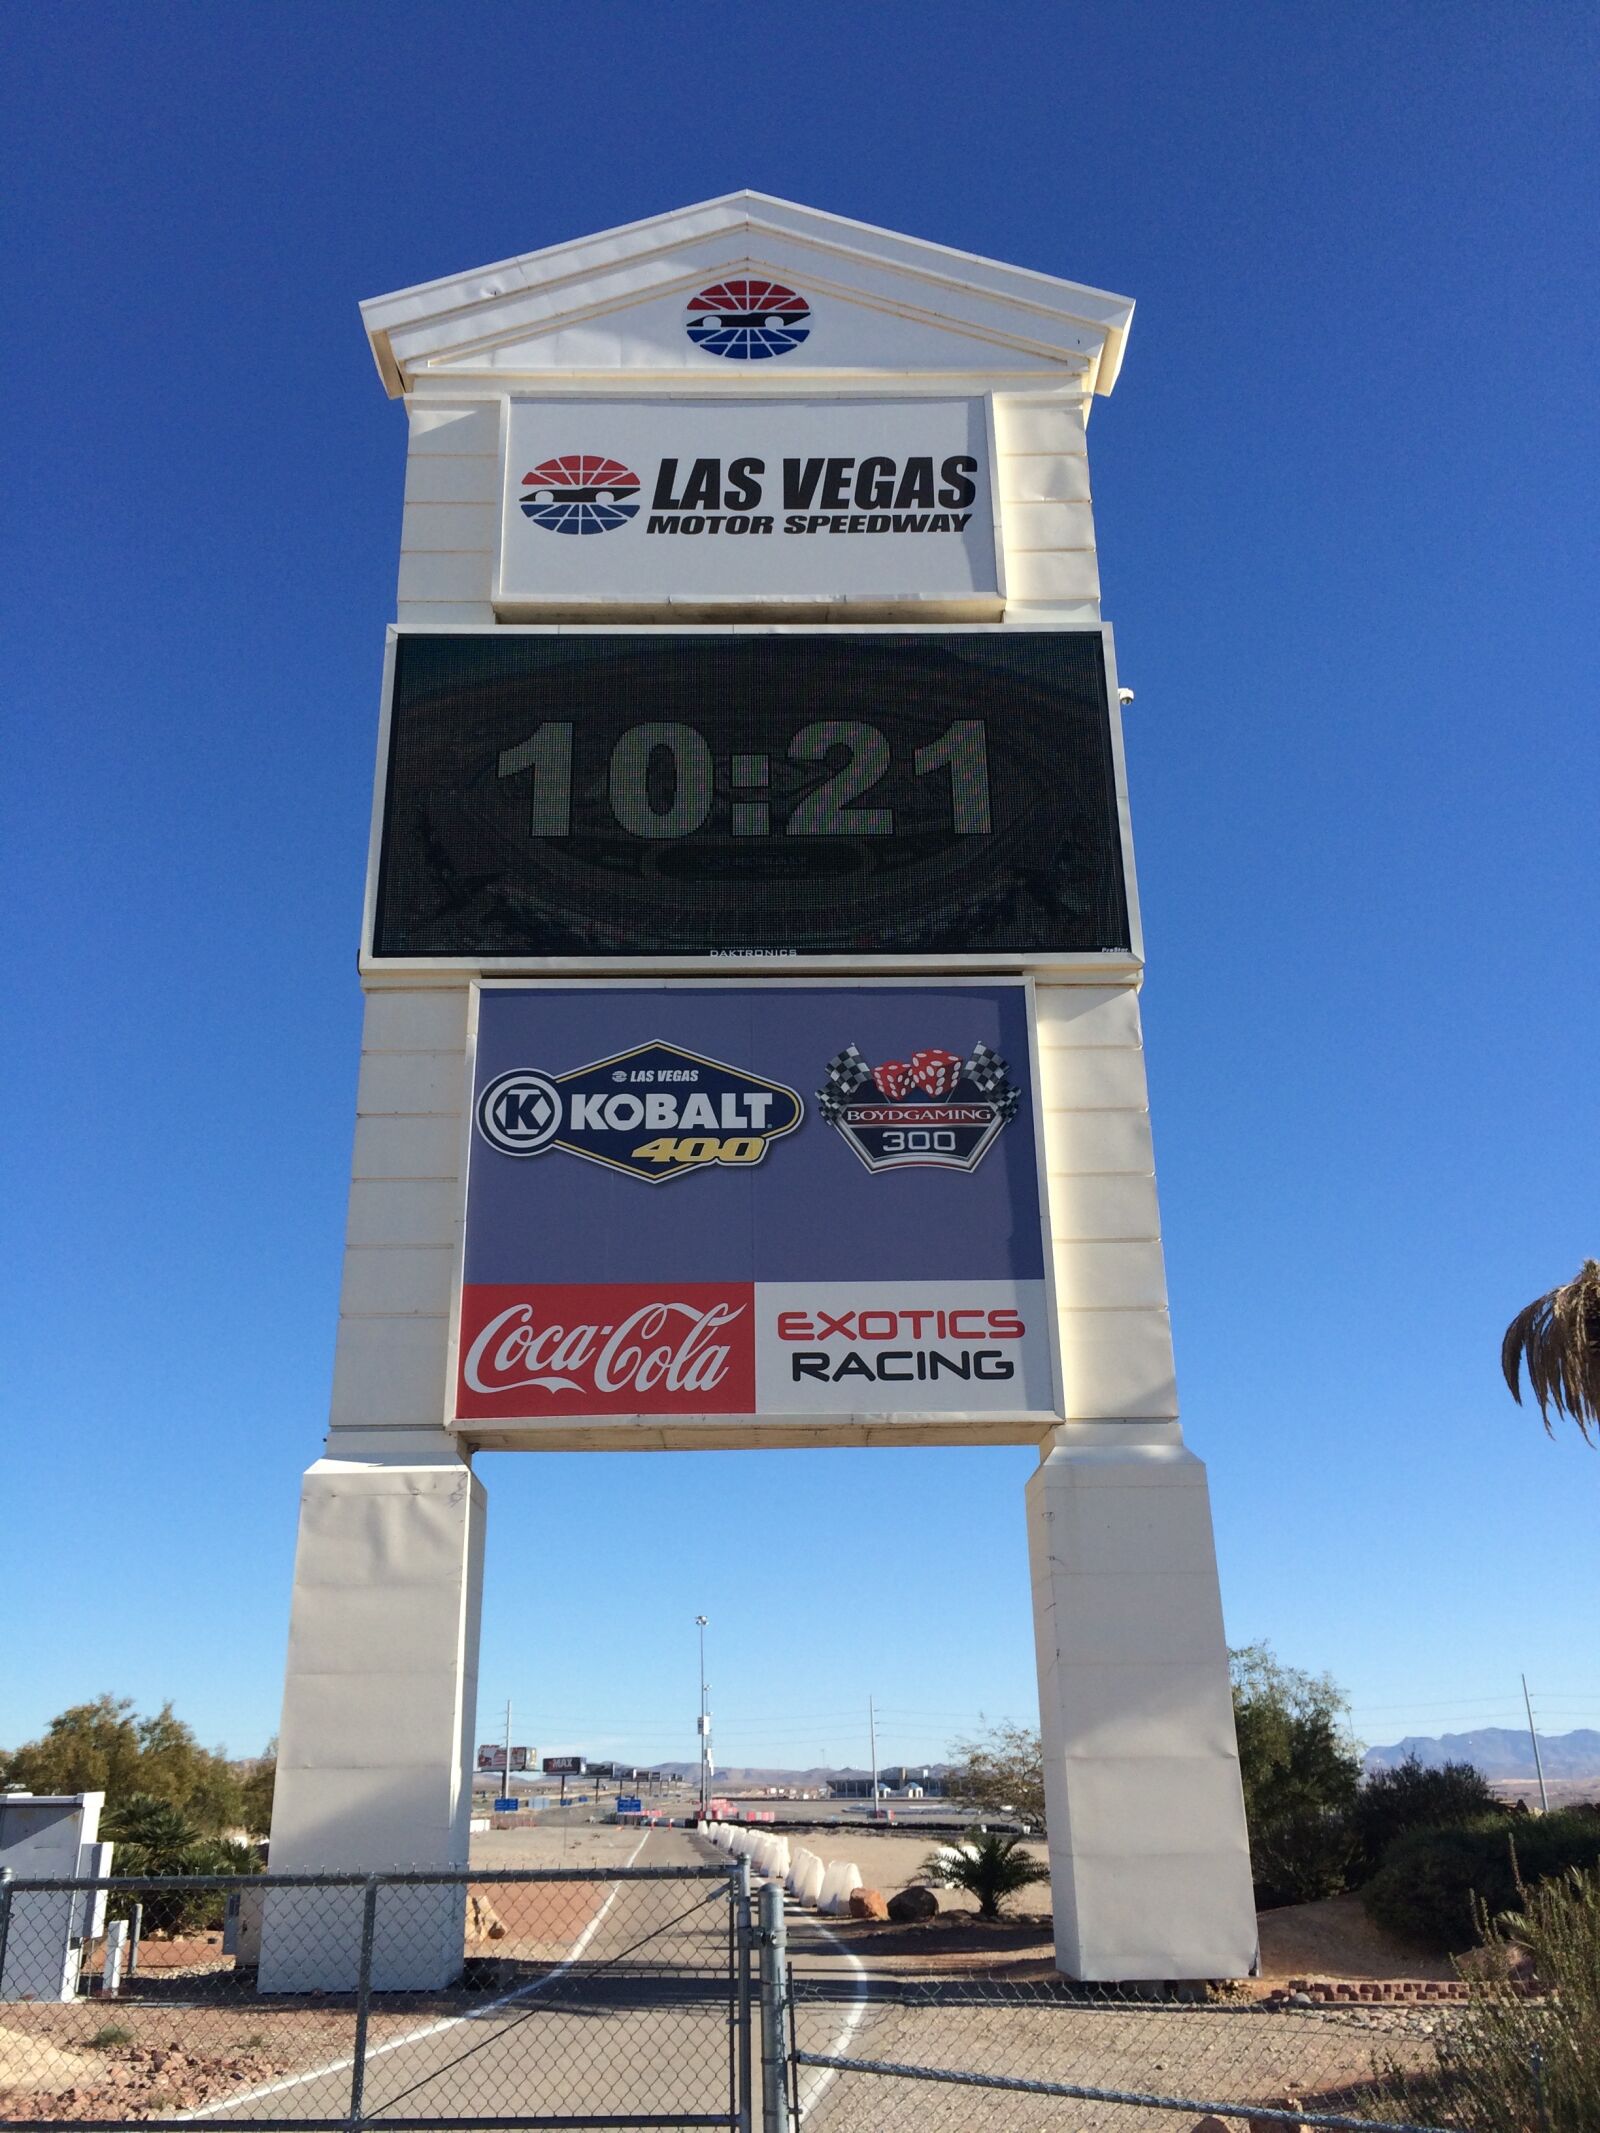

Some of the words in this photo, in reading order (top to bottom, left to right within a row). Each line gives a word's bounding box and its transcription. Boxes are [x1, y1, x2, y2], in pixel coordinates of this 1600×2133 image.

[651, 457, 765, 511] LAS
[783, 455, 978, 510] VEGAS
[646, 515, 774, 535] MOTOR
[783, 513, 973, 534] SPEEDWAY
[497, 719, 992, 839] 10:21
[710, 949, 798, 957] DAKTRONICS
[630, 1070, 654, 1083] LAS
[657, 1070, 699, 1083] VEGAS
[570, 1092, 773, 1131] KOBALT
[631, 1137, 765, 1162] 400
[882, 1131, 956, 1151] 300
[777, 1309, 1026, 1341] EXOTICS
[464, 1302, 748, 1394] Coca-Cola
[792, 1350, 1014, 1382] RACING
